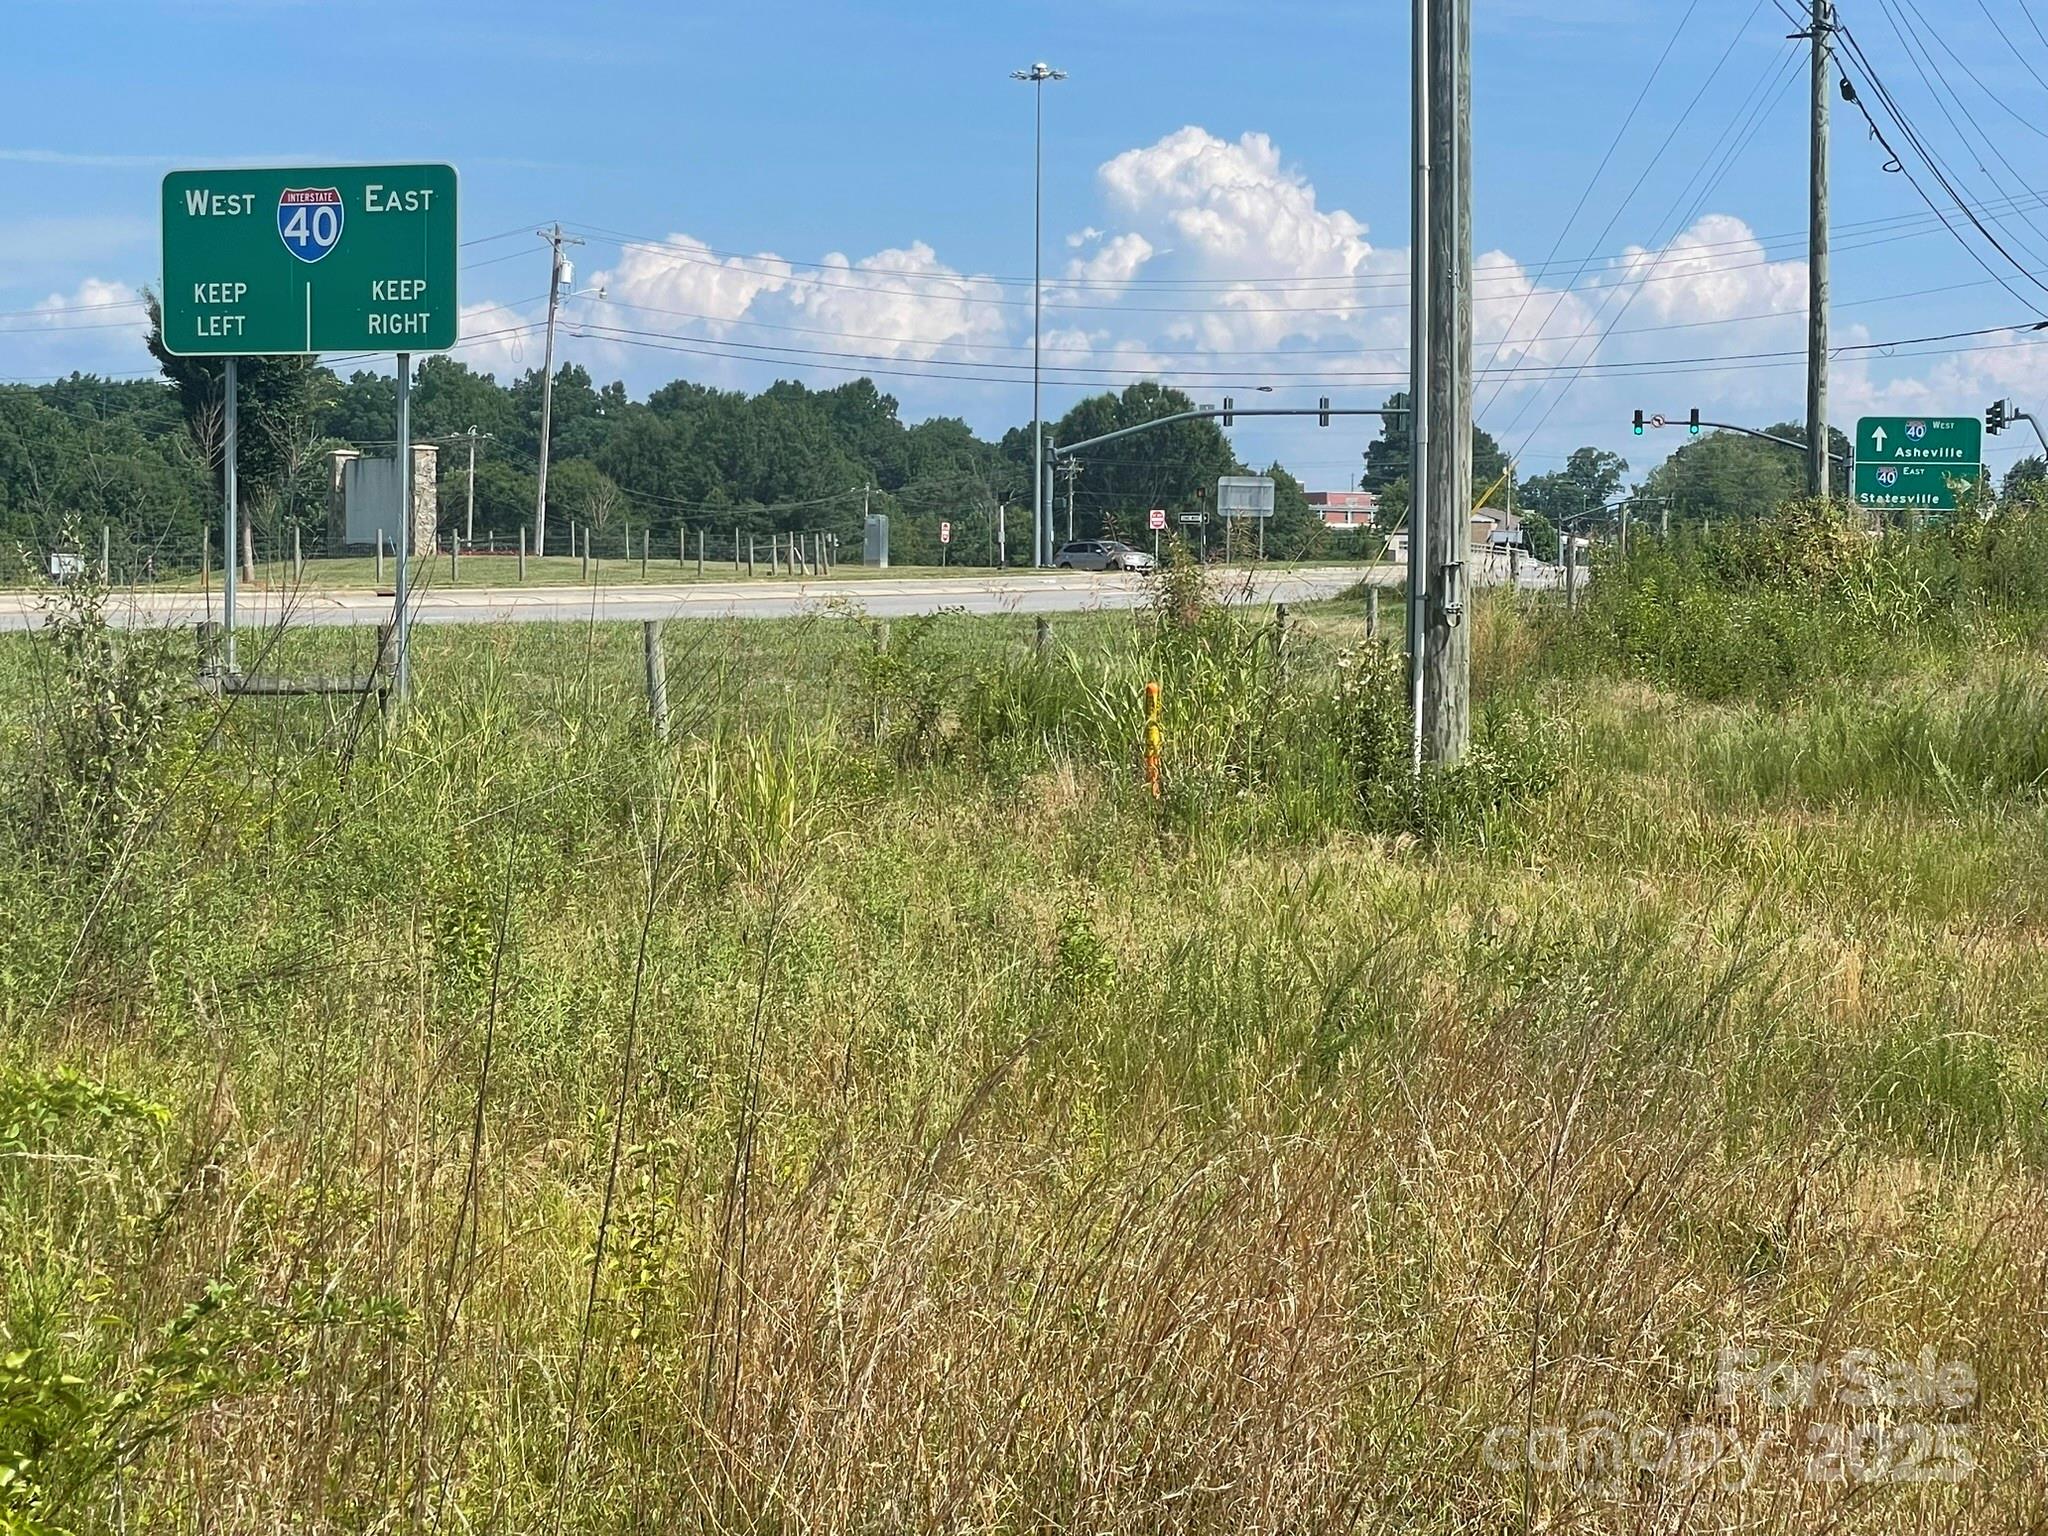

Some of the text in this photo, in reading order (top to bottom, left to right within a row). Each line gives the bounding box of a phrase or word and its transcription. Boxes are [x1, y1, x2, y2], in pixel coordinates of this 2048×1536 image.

[287, 192, 333, 203] INTERSTATE
[284, 205, 338, 247] 40
[194, 282, 247, 303] KEEP
[372, 279, 427, 301] KEEP
[197, 316, 246, 336] LEFT
[368, 313, 431, 335] RIGHT
[1907, 426, 1924, 438] 40
[1895, 447, 1963, 458] Asheville
[1878, 472, 1896, 484] 40
